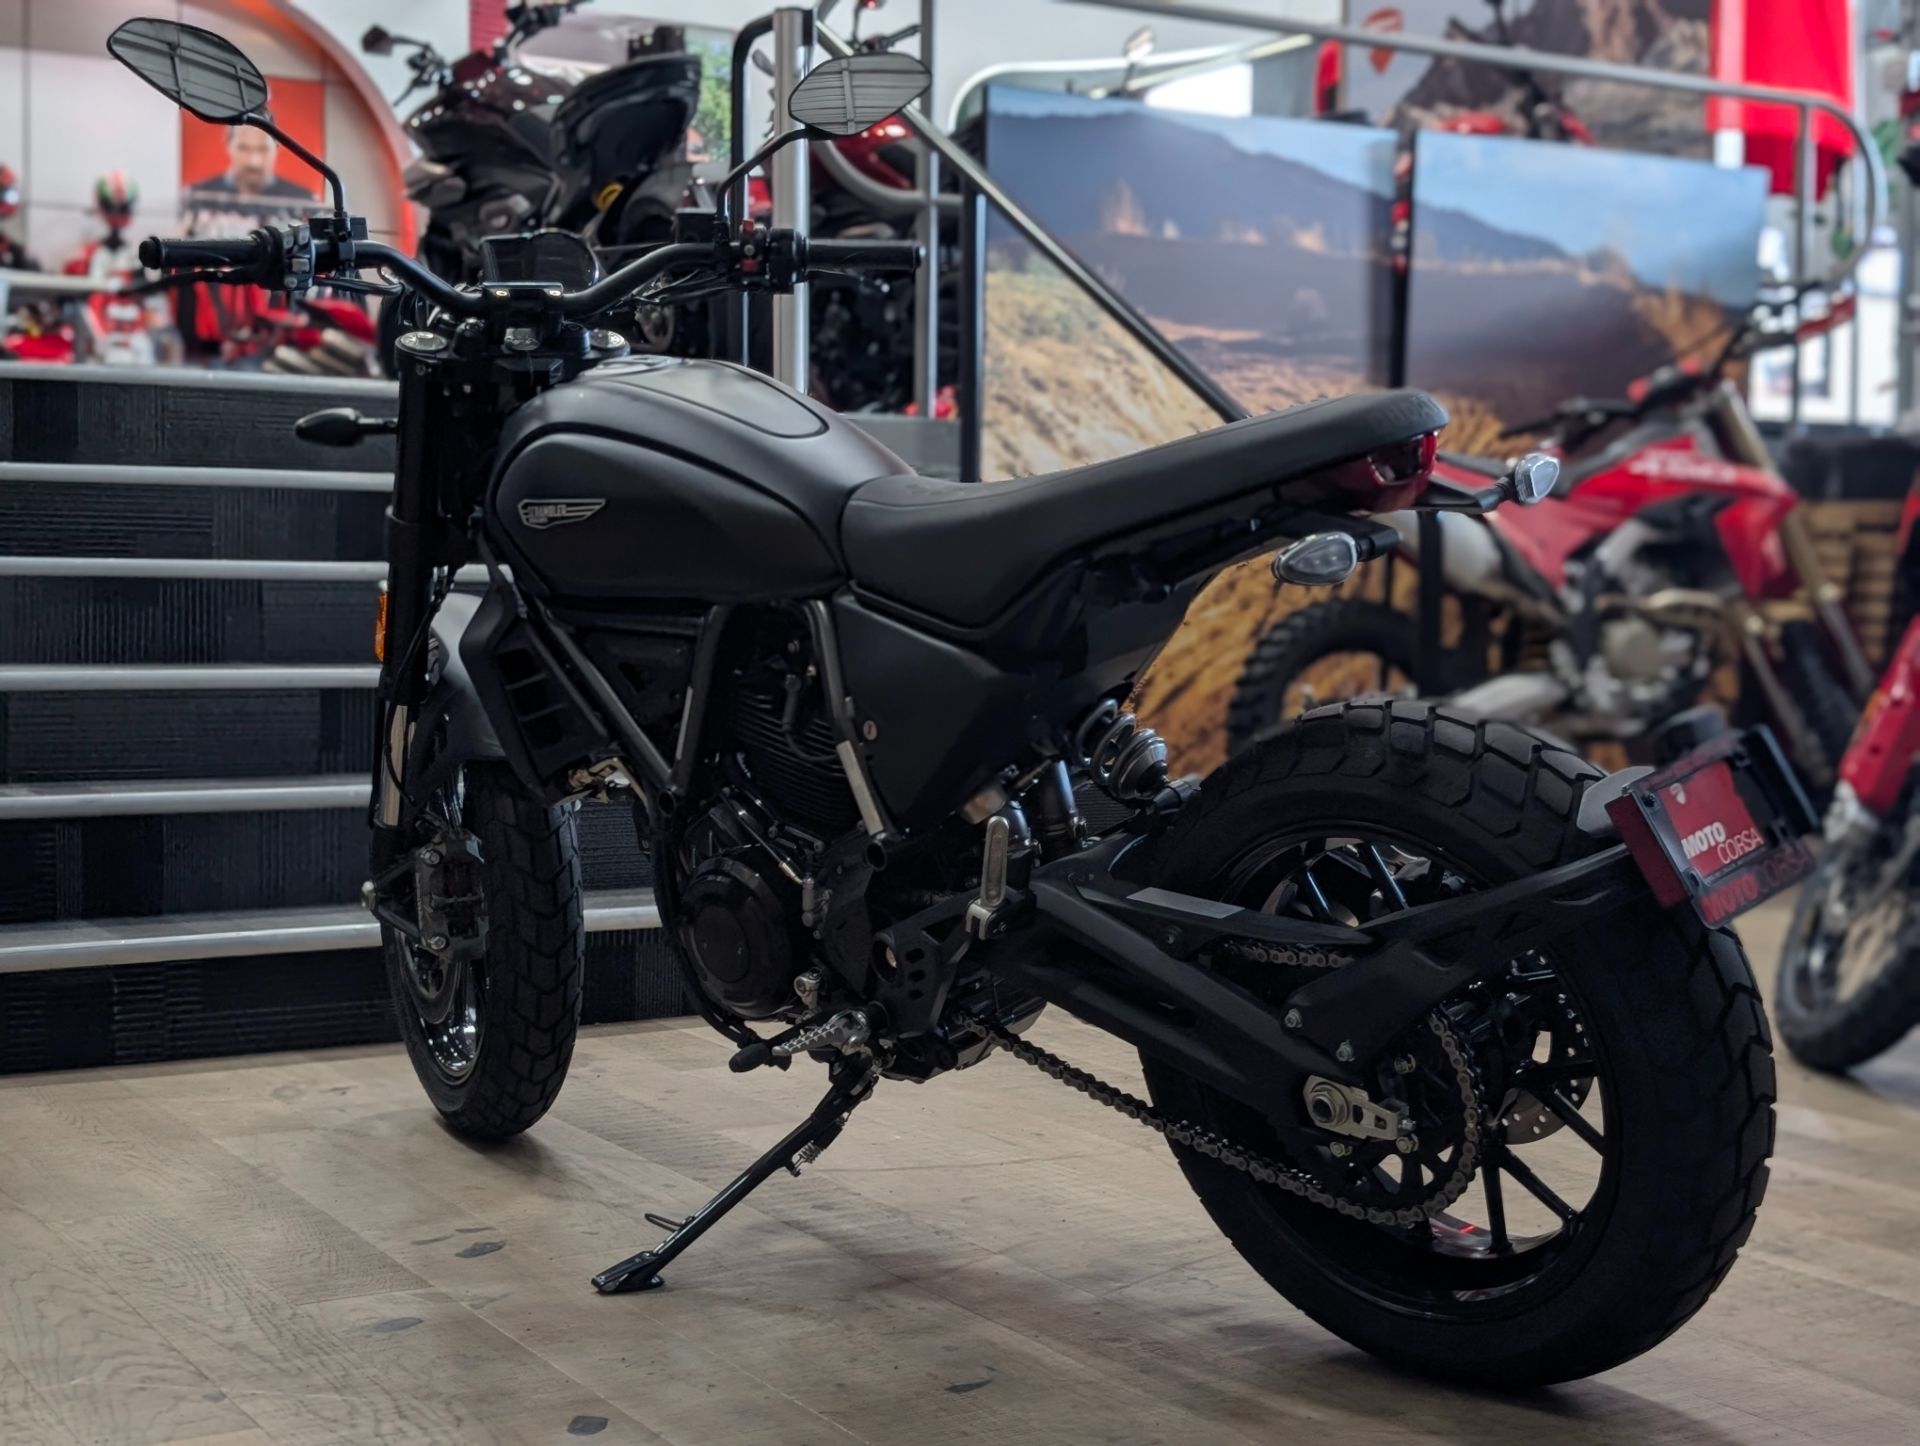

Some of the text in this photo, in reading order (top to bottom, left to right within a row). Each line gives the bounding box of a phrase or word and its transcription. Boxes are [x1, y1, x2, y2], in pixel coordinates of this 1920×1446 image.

[1680, 821, 1727, 860] MOTO
[1716, 827, 1766, 865] CORSA
[1702, 873, 1759, 922] MOTO
